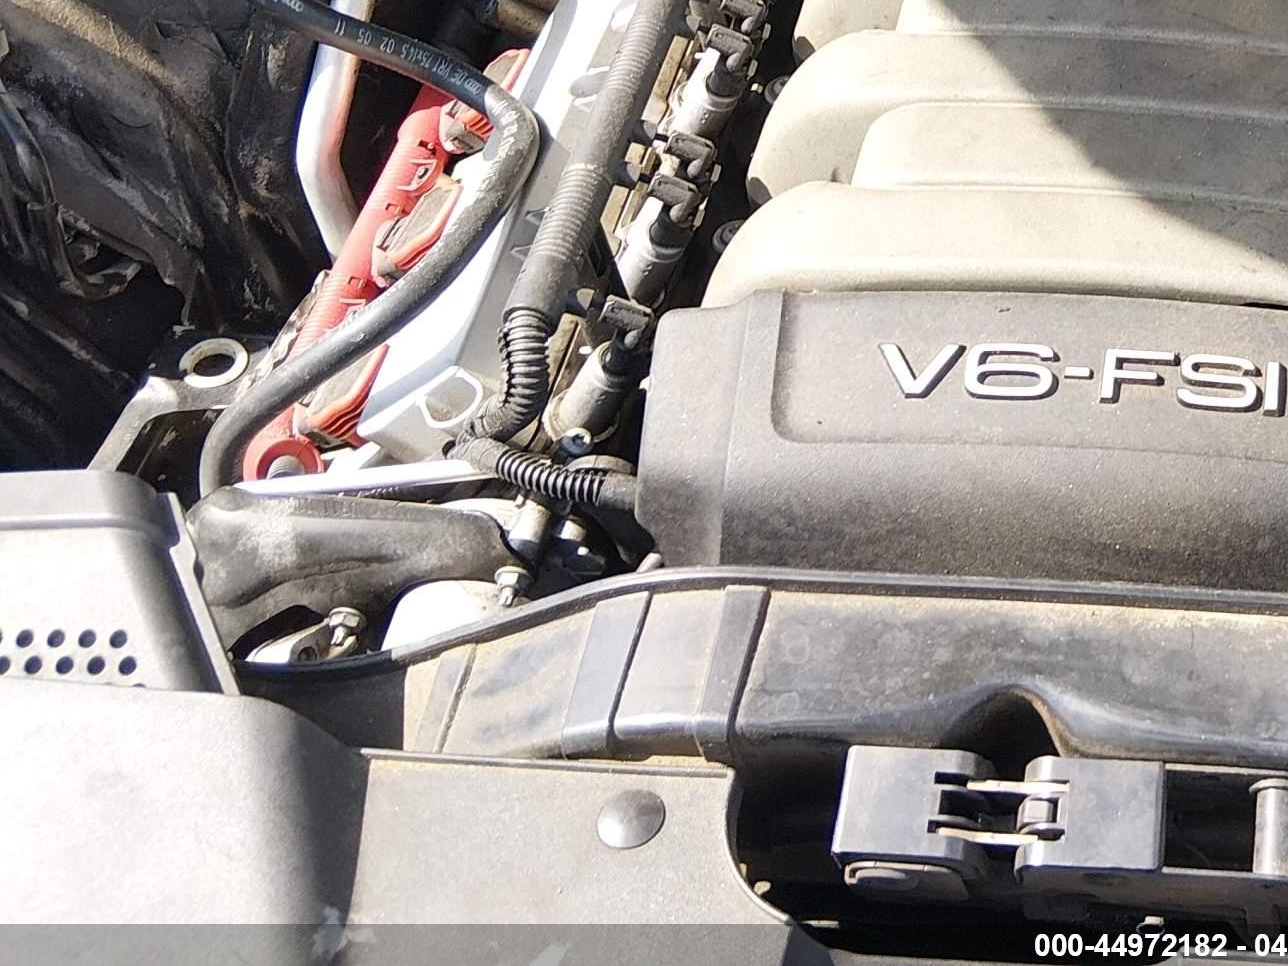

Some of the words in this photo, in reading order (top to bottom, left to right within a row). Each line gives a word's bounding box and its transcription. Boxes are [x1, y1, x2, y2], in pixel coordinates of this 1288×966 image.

[357, 28, 372, 46] 05
[380, 36, 396, 52] 02
[879, 343, 1288, 417] V6-FSI
